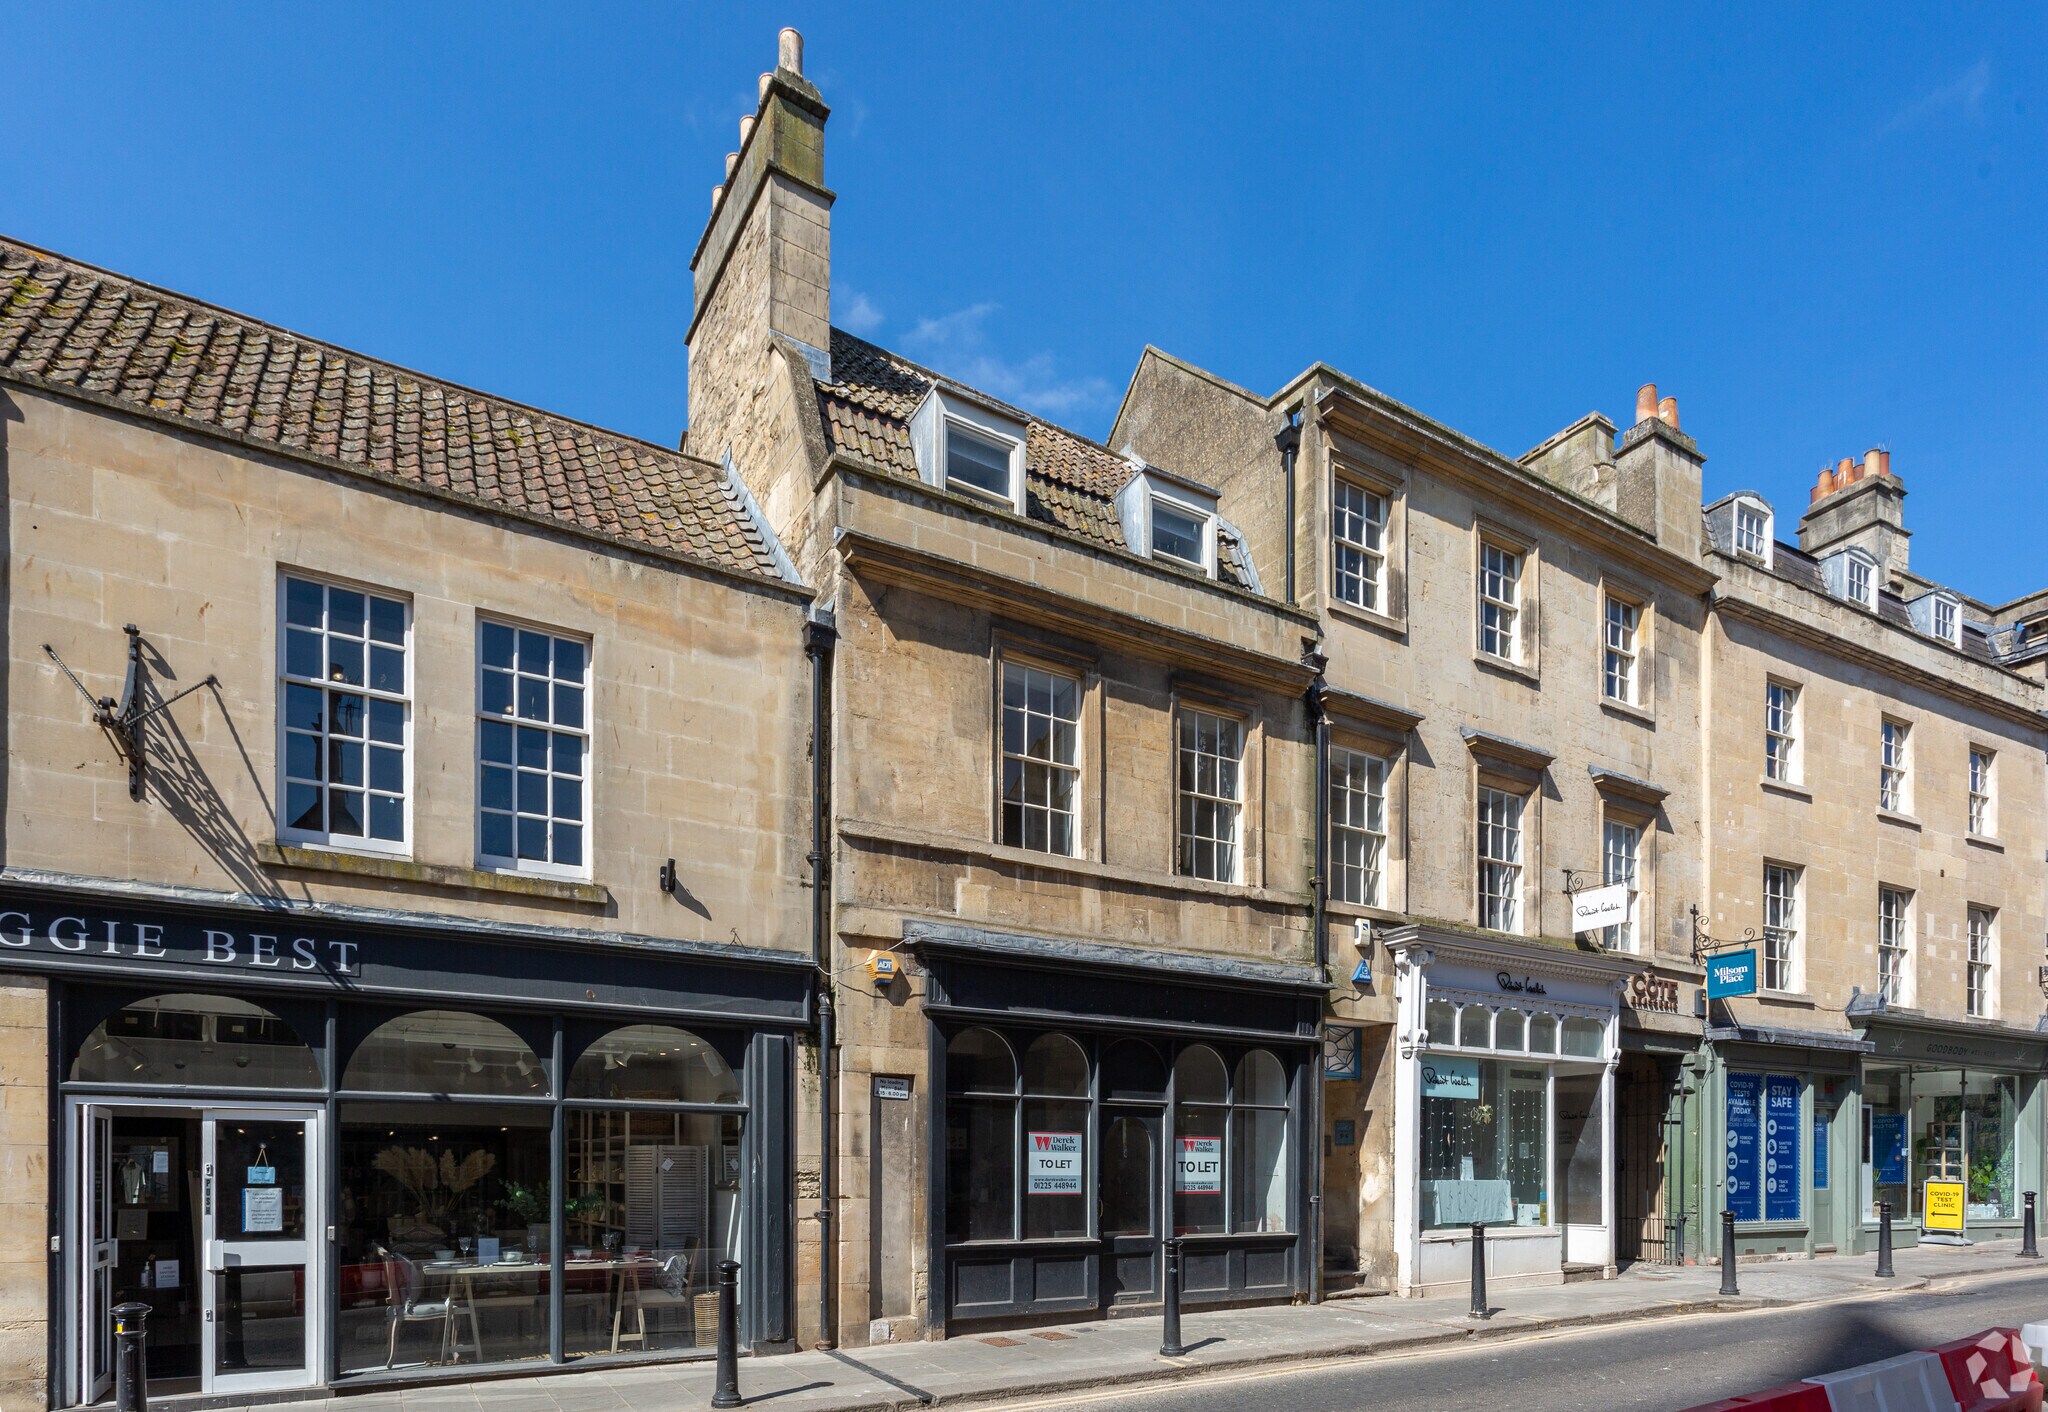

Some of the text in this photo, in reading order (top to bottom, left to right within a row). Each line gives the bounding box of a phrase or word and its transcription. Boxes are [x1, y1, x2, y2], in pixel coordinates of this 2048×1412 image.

[202, 929, 358, 973] BEST
[878, 960, 892, 970] ADT
[1713, 965, 1748, 978] Milsom
[1719, 973, 1744, 984] Place
[1631, 970, 1679, 1000] CÔTE
[1926, 1043, 1968, 1056] GOODBODY
[1730, 1081, 1754, 1089] COVID-19
[1771, 1085, 1792, 1097] STAY
[1728, 1098, 1756, 1107] AVAILABLE
[1771, 1097, 1792, 1108] SAFE
[1732, 1107, 1752, 1115] TODAY
[1051, 1143, 1077, 1151] Walker
[1039, 1159, 1072, 1169] TO LET
[1178, 1161, 1218, 1173] TO LET
[1034, 1182, 1077, 1190] 01225 448944
